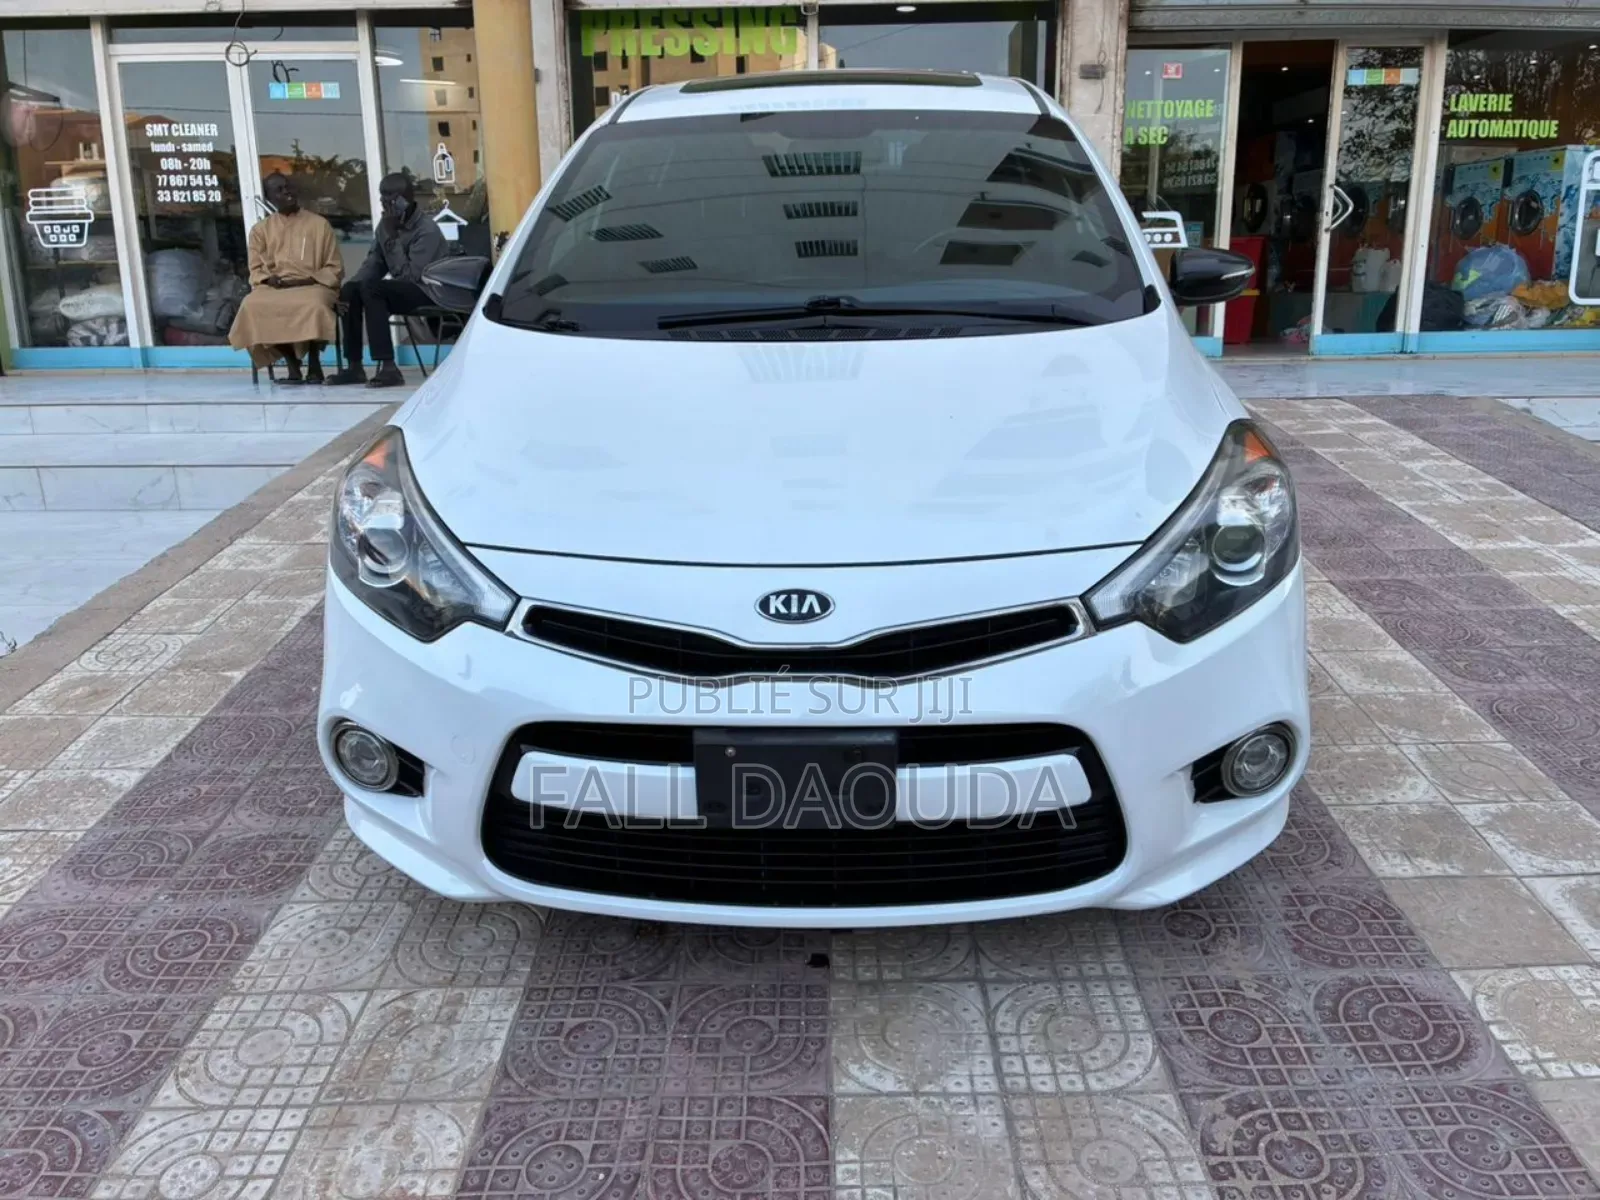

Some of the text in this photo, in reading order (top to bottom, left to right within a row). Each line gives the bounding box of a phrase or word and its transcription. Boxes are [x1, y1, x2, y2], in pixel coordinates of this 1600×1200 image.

[581, 8, 798, 56] PRESSING
[1127, 100, 1215, 119] NETTOYAGE
[1449, 93, 1513, 112] LAVERIE
[145, 123, 219, 137] SMT CLEANER
[1138, 126, 1169, 145] SEC
[1446, 119, 1559, 139] AUTOMATIQUE
[160, 157, 182, 170] 08h
[189, 157, 211, 170] 20h
[156, 175, 219, 187] 77 867 54 54
[157, 190, 222, 202] 33 821 85 20
[769, 594, 821, 614] KIA
